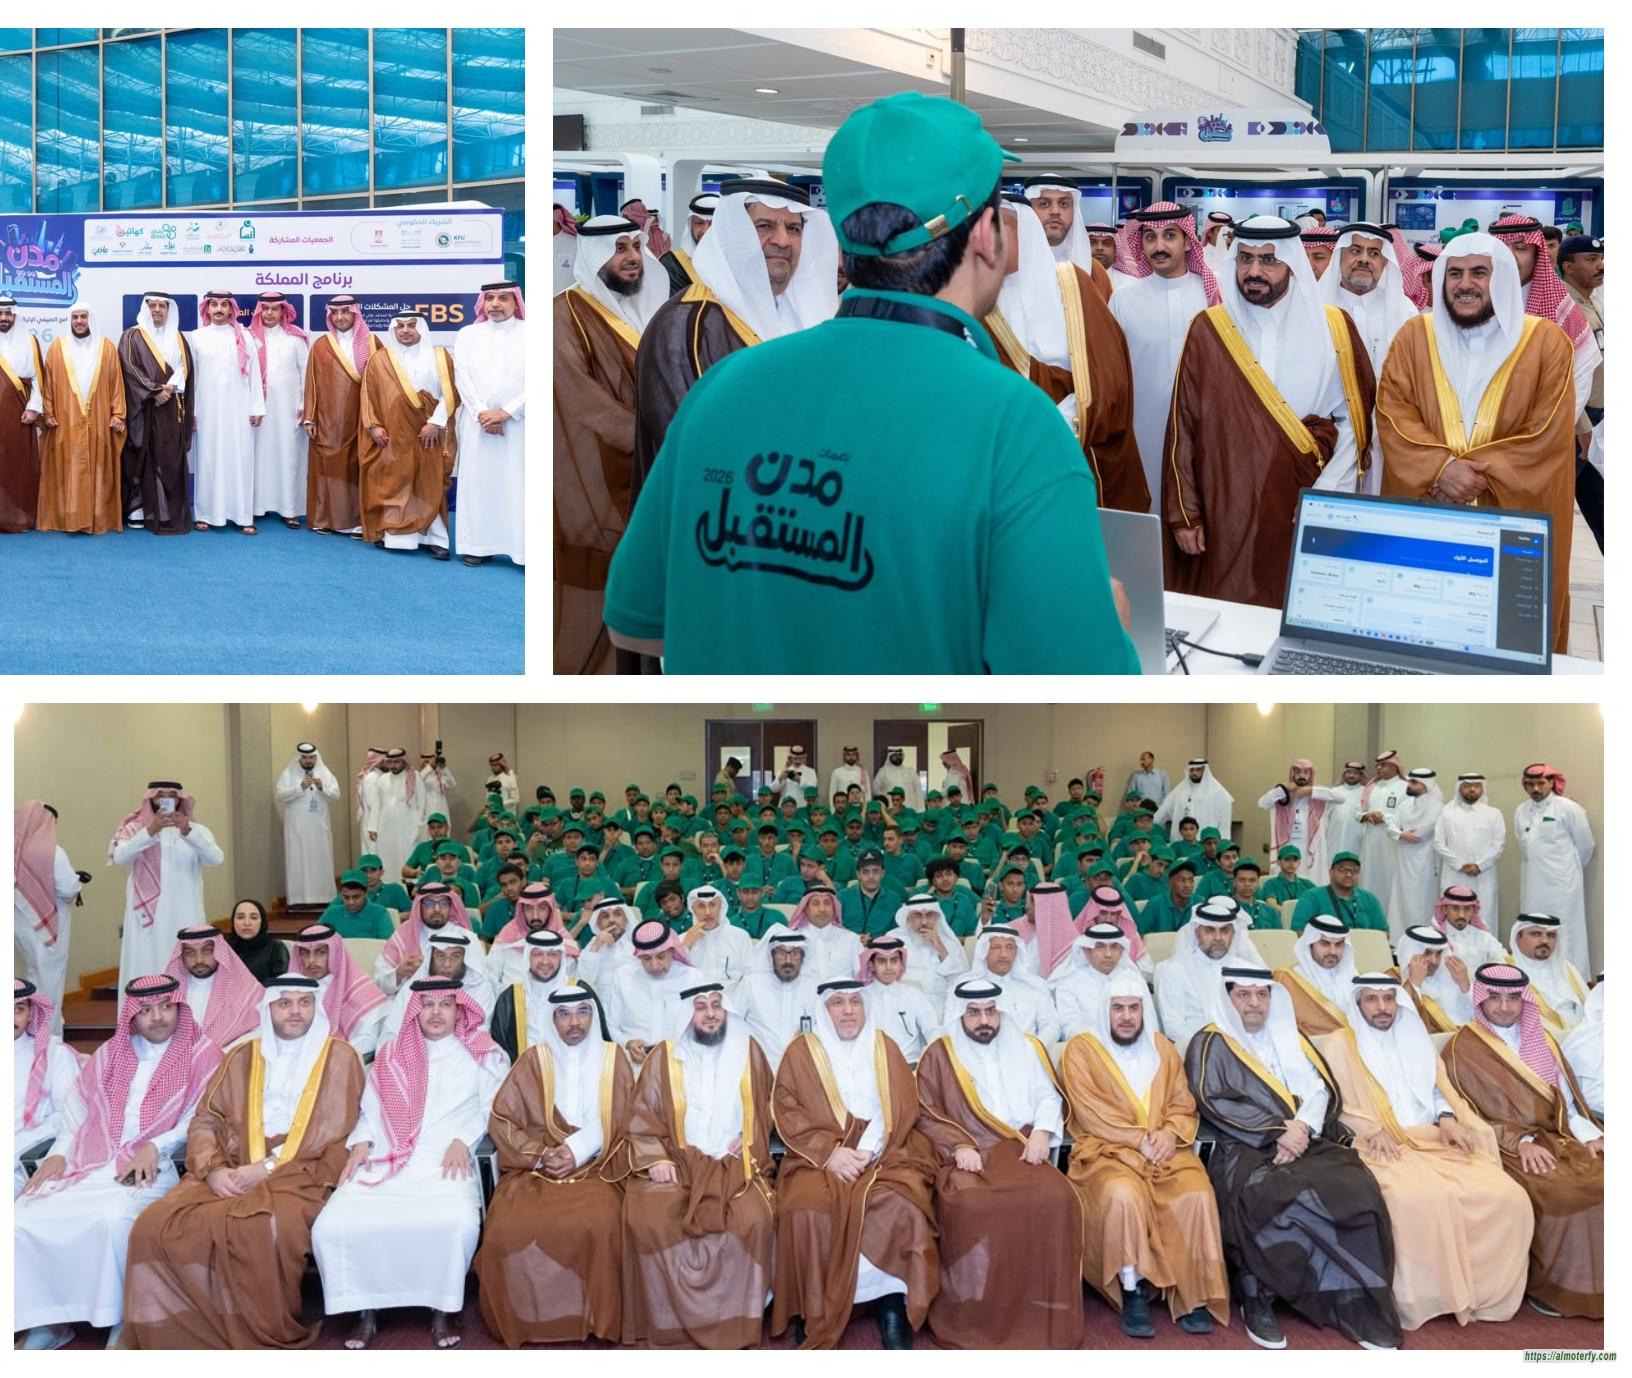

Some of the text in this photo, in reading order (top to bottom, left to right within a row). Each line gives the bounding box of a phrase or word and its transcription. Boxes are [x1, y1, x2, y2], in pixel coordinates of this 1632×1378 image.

[428, 218, 453, 228] الشريك
[268, 235, 334, 245] الجمعيات المشاركة
[7, 244, 61, 271] مدن
[255, 272, 353, 290] برنامج المملكة
[363, 303, 411, 311] حل المشكلات
[703, 467, 735, 486] 2026
[745, 451, 843, 507] مدن
[696, 488, 873, 590] المستقبل
